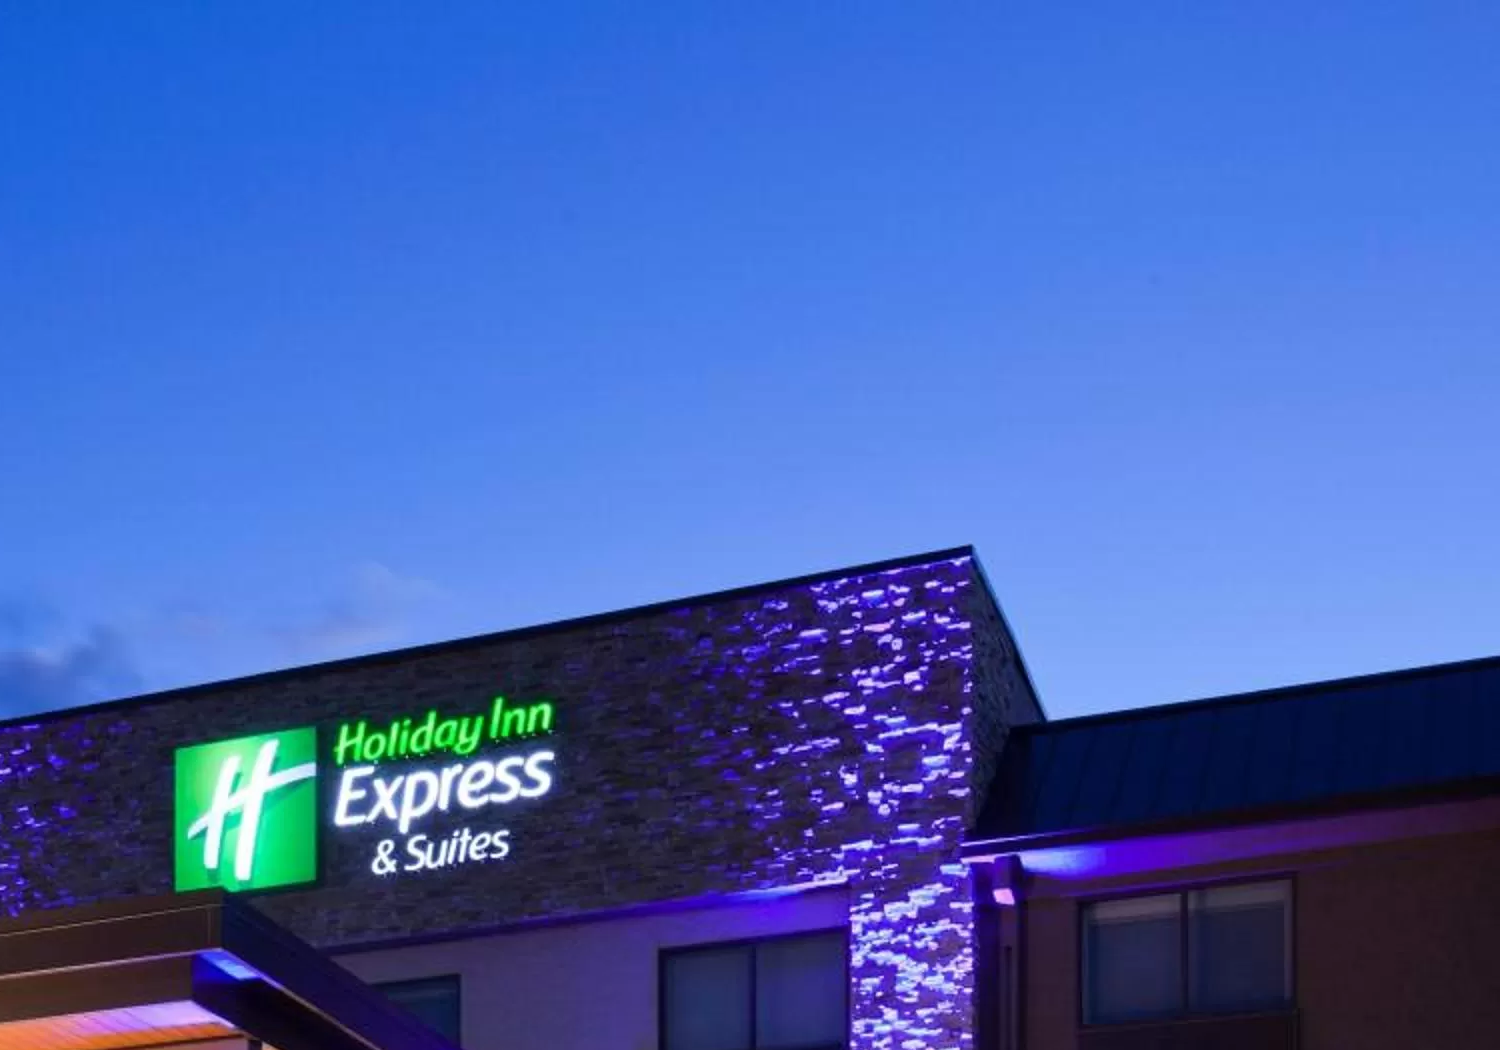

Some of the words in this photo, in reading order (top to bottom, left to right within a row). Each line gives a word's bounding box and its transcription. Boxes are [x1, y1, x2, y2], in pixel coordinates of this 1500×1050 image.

[333, 711, 483, 764] Holiday
[490, 697, 552, 743] Inn
[333, 750, 555, 833] Express
[371, 838, 397, 875] &
[404, 829, 510, 873] Suites
